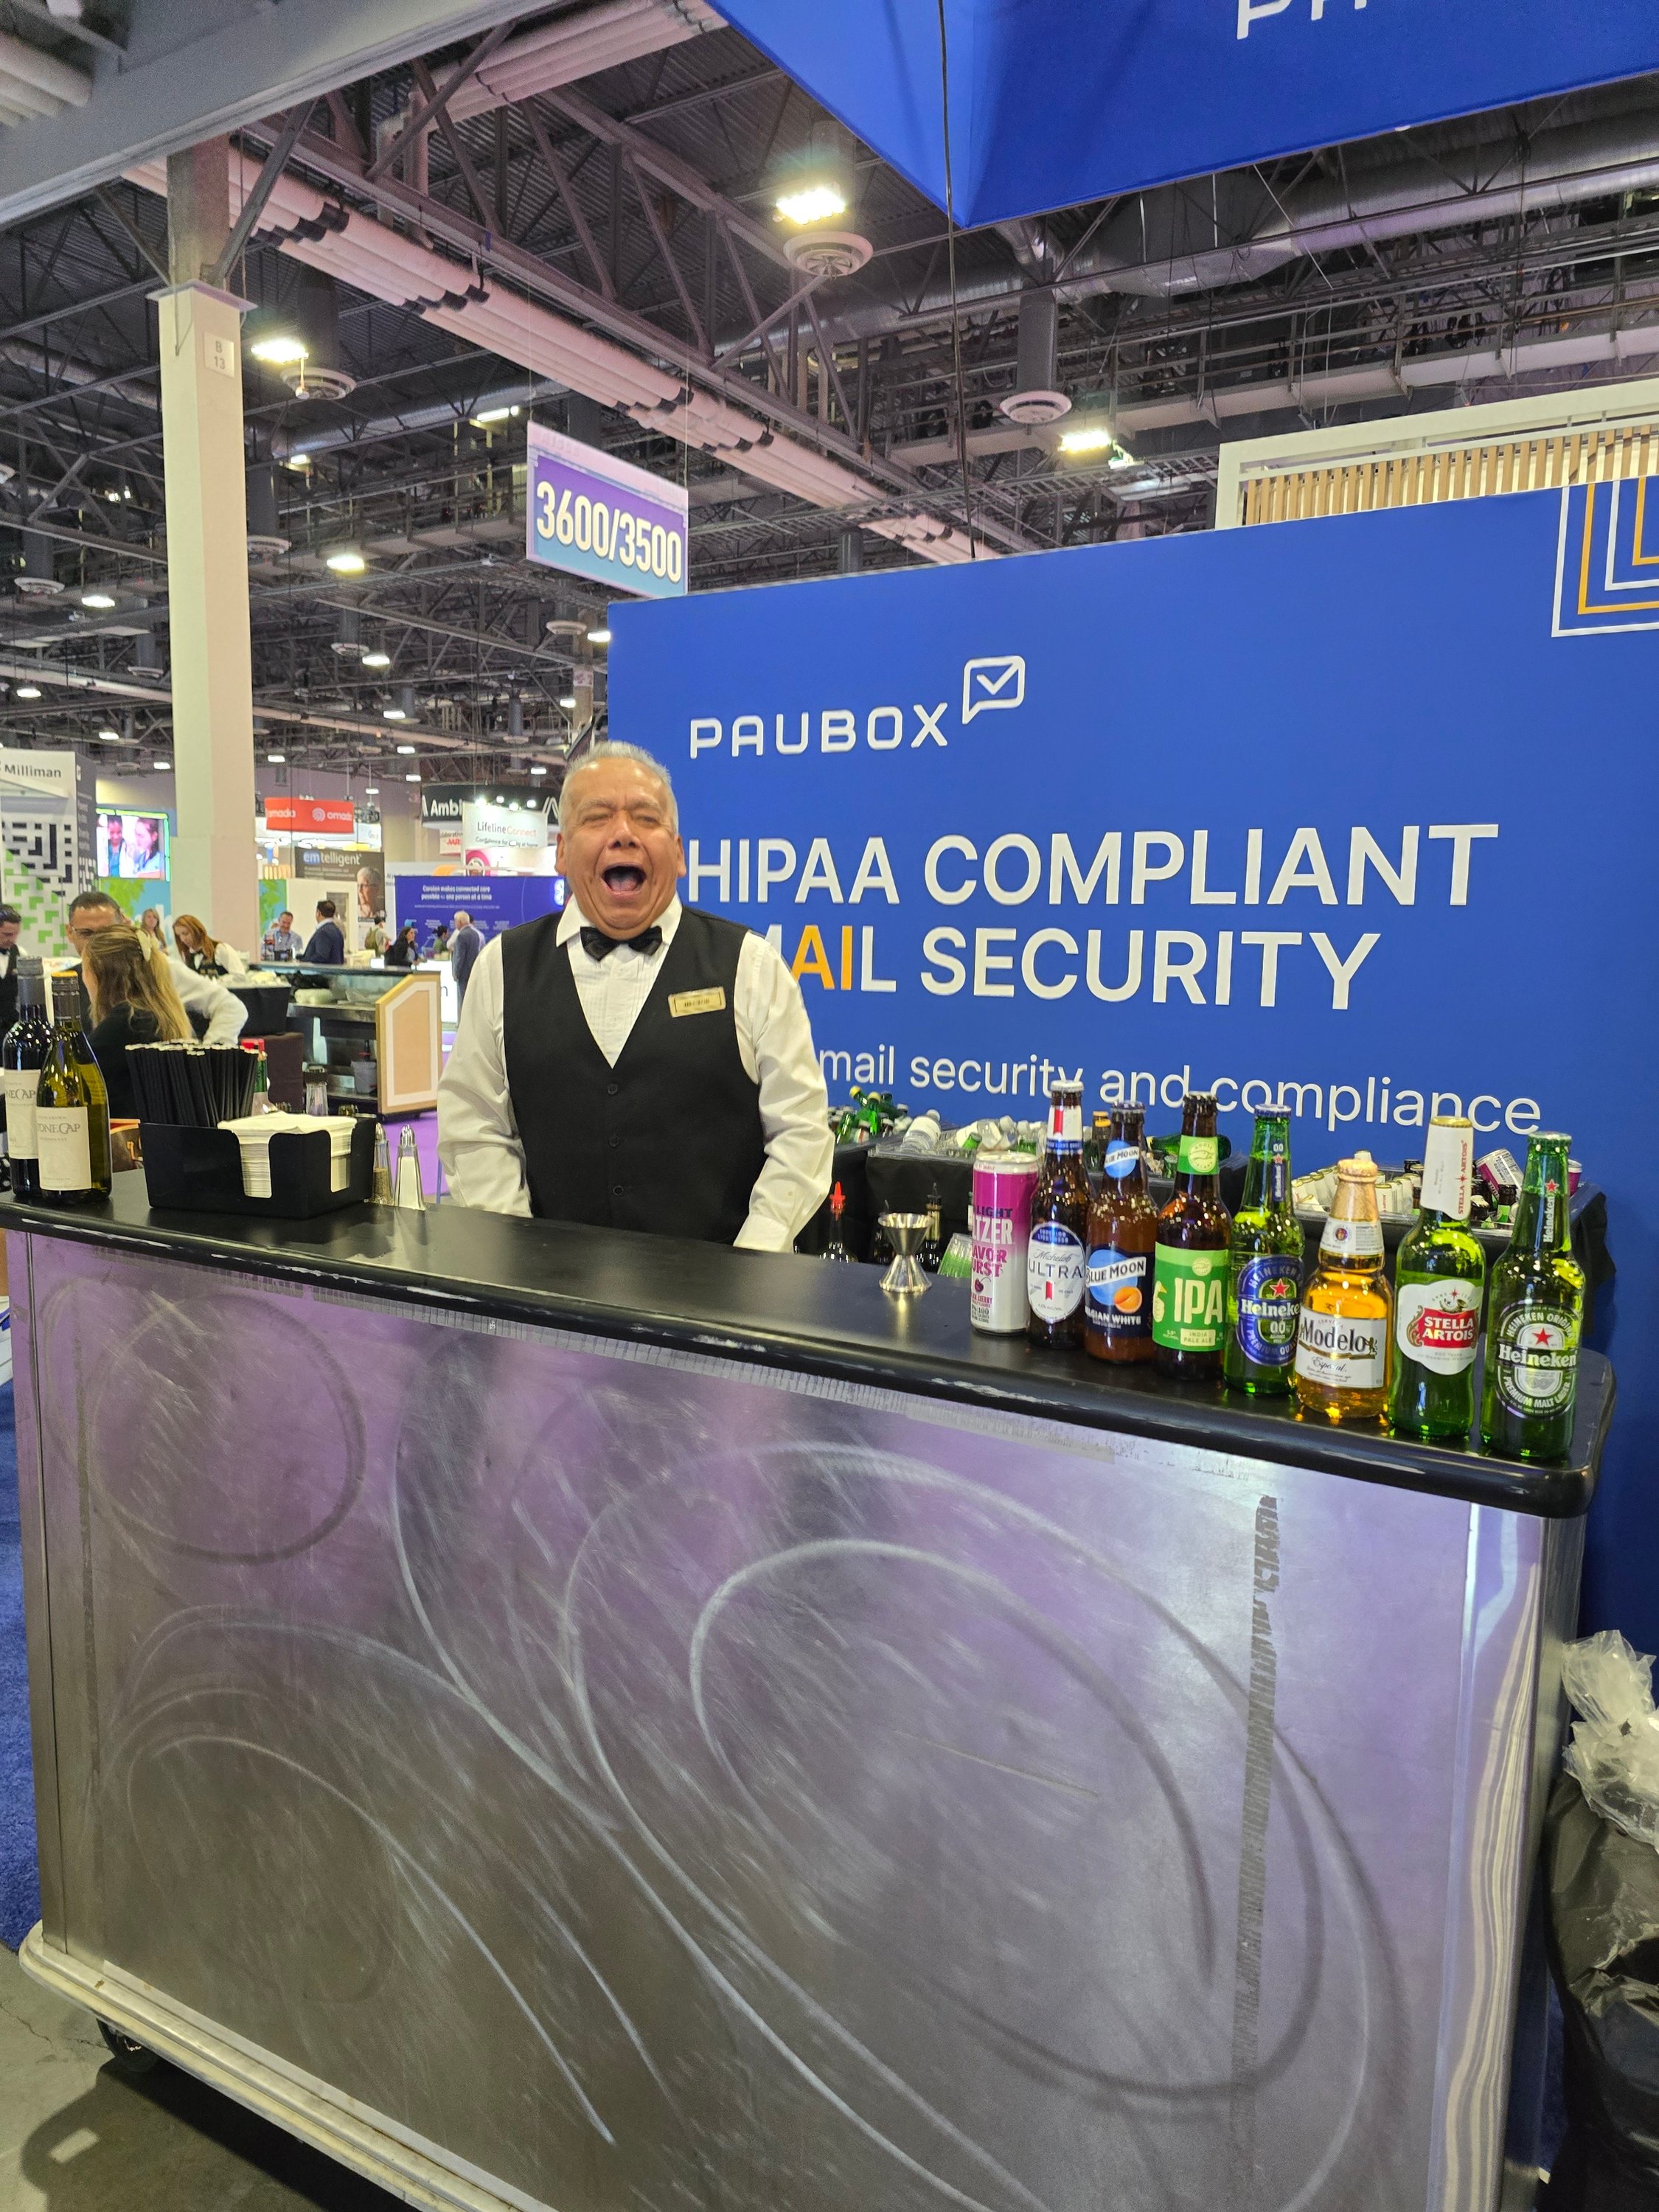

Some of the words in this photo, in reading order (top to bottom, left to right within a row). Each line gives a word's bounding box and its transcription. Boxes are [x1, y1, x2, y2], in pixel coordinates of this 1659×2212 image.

[215, 341, 223, 353] B
[214, 355, 226, 369] 13
[536, 480, 682, 584] 3600/3500
[689, 701, 949, 759] PAUBOX
[4, 764, 62, 779] Milliman
[303, 851, 361, 866] emtelligent
[688, 836, 900, 904] HIPAA
[924, 824, 1499, 906] COMPLIANT
[764, 924, 897, 992] AIL
[920, 925, 1381, 1010] SECURITY
[1099, 1065, 1190, 1107] and
[1210, 1077, 1541, 1135] compliance
[1457, 1184, 1466, 1215] STELLA
[976, 1206, 1013, 1218] LIGHT
[1543, 1194, 1555, 1243] Heineken
[1034, 1249, 1073, 1262] Michelob
[1028, 1258, 1083, 1279] ULTRA
[1085, 1267, 1107, 1284] BLUE
[1110, 1260, 1144, 1279] MOON
[1174, 1277, 1223, 1325] IPA
[1241, 1298, 1301, 1317] Heineke
[1111, 1314, 1141, 1325] WHITE
[1424, 1316, 1474, 1329] STELLA
[1506, 1312, 1545, 1338] HEINEKEN
[1546, 1312, 1574, 1339] ORIGINA
[1303, 1316, 1366, 1352] Modelo
[1422, 1328, 1474, 1341] ARTOIS
[1498, 1343, 1577, 1368] Heineken
[1533, 1399, 1554, 1408] MALT
